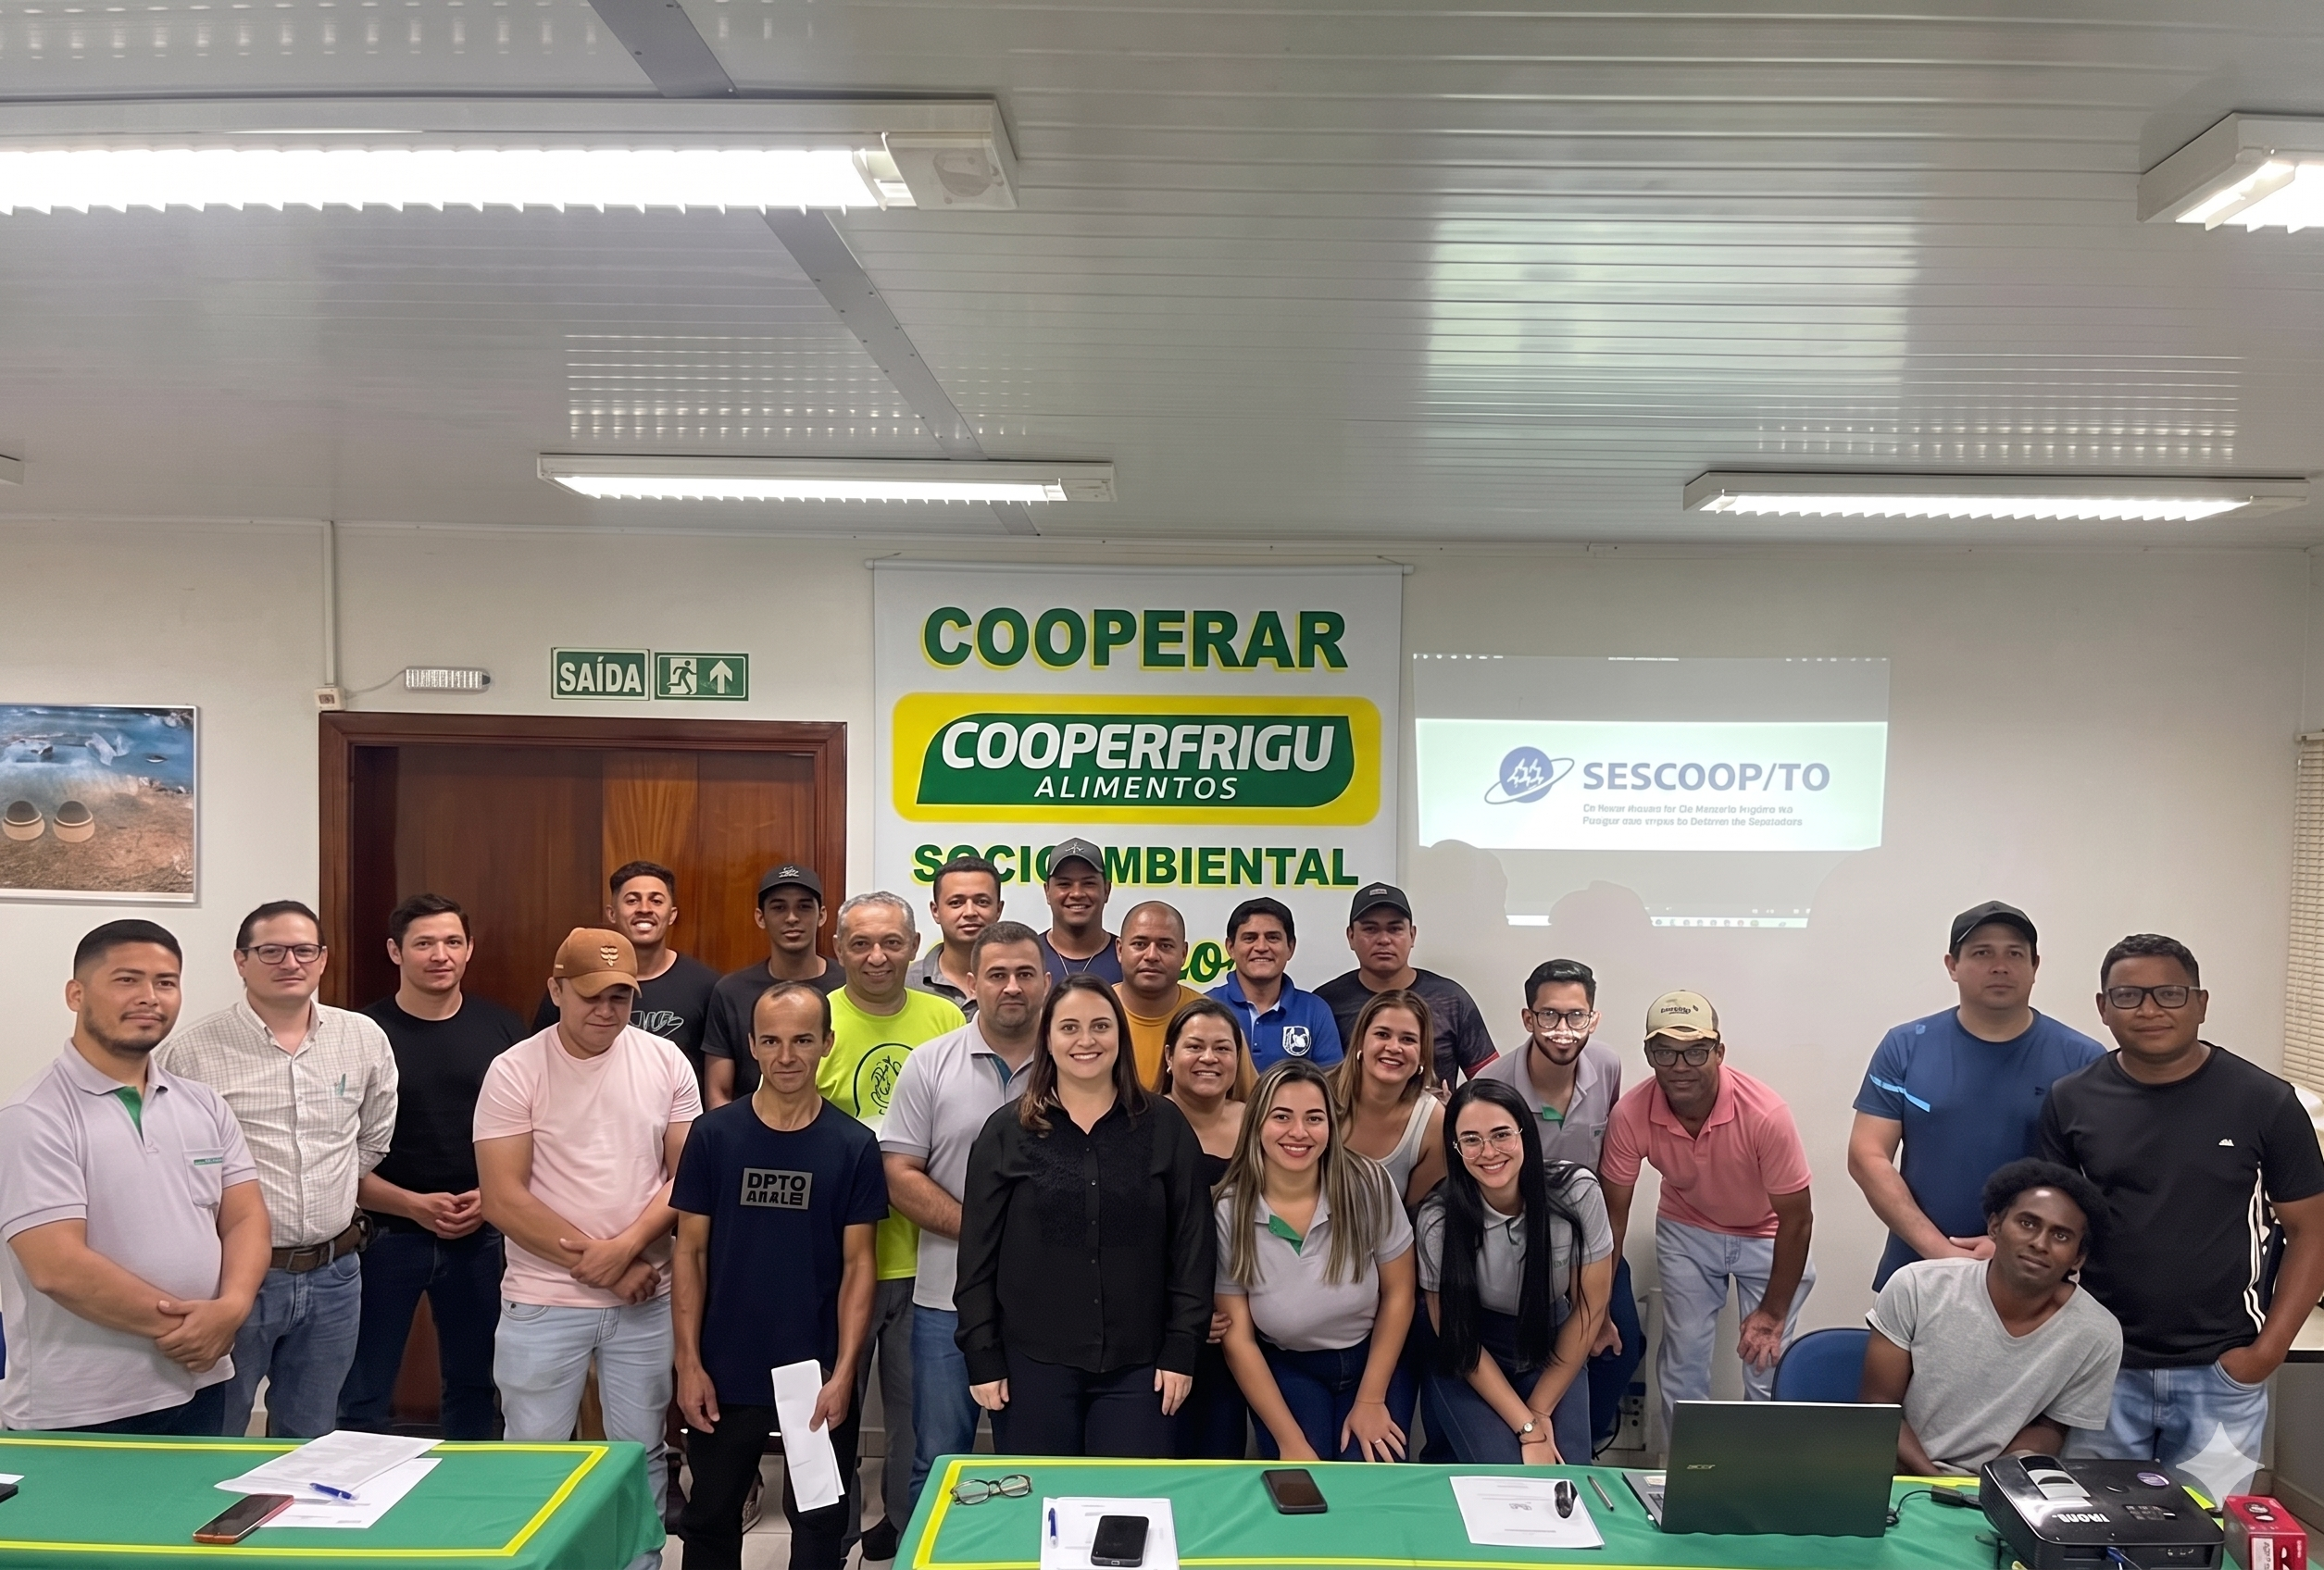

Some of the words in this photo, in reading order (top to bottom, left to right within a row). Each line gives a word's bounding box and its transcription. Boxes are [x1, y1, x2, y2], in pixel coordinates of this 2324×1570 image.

[923, 606, 1349, 669] COOPERAR
[559, 656, 643, 693] SAÍDA
[942, 721, 1335, 772] COOPERFRIGU
[1034, 776, 1238, 800] ALIMENTOS
[1582, 762, 1830, 791] SESCOOP/TO
[913, 844, 1359, 886] SCIMBIENTAL
[747, 1172, 806, 1192] DPTO
